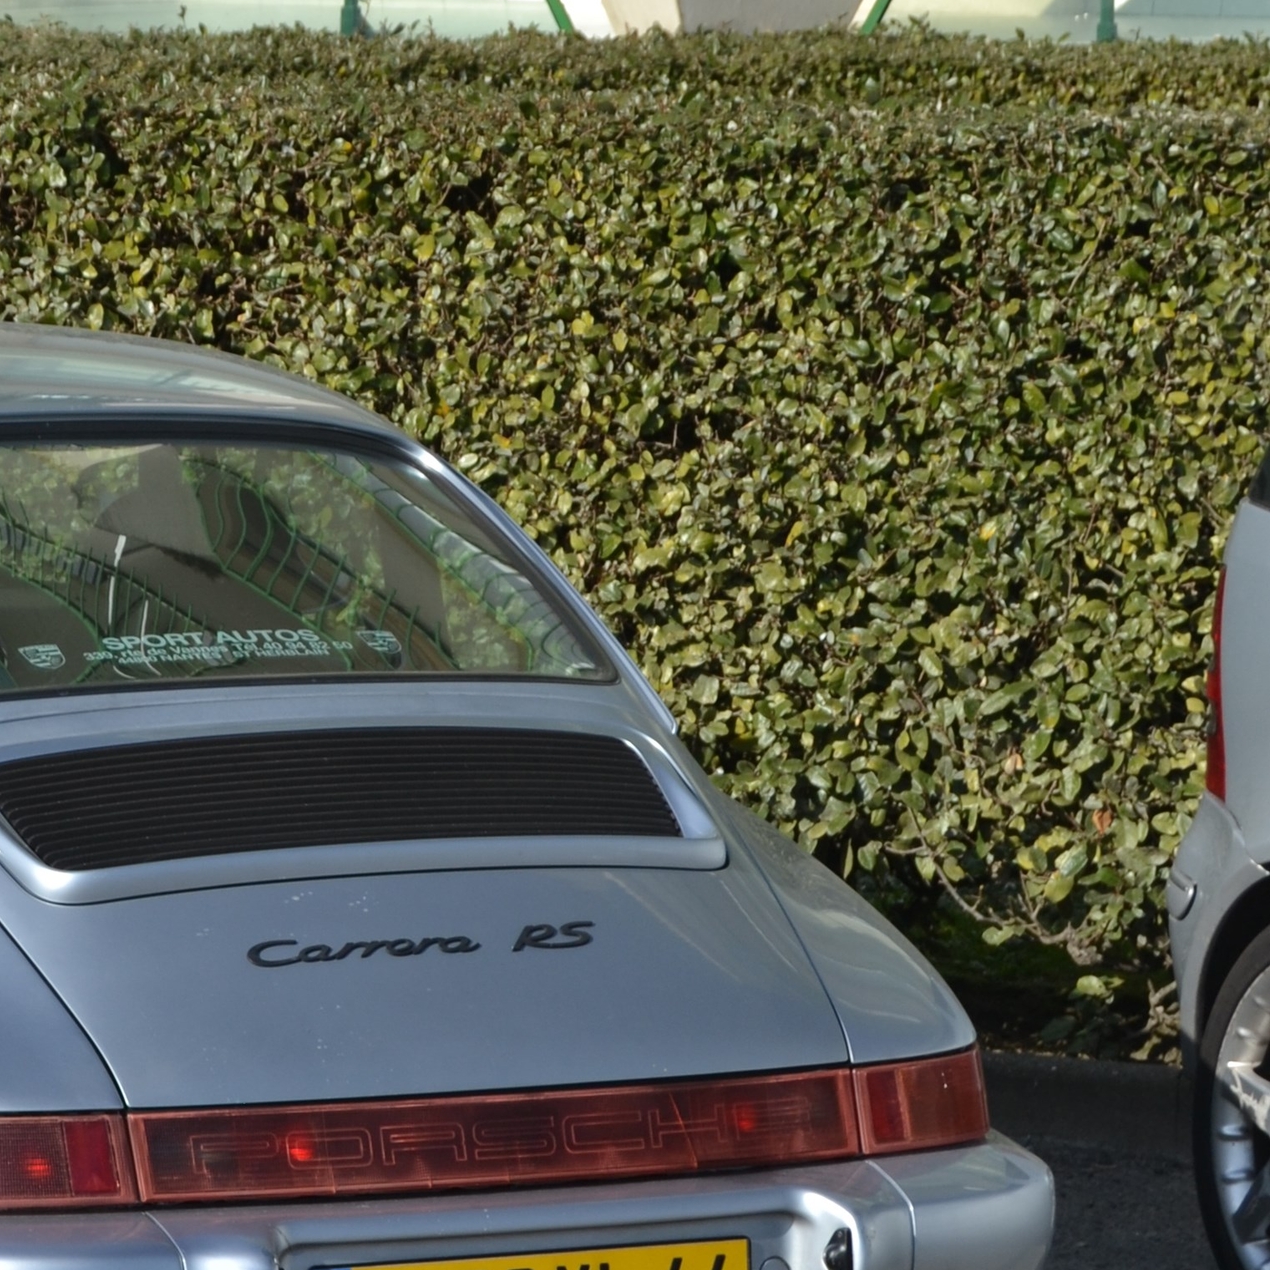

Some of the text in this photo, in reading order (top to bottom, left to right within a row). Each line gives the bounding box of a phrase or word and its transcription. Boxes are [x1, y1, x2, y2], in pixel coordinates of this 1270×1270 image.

[102, 628, 321, 651] SPORT AUTOS
[147, 647, 167, 657] de
[169, 644, 229, 655] Vannes
[118, 654, 158, 664] 4480
[159, 650, 223, 661] NANTES
[254, 648, 330, 657] HERBLAIN
[246, 920, 597, 968] Carrera RS
[190, 1095, 815, 1174] PORSCHE
